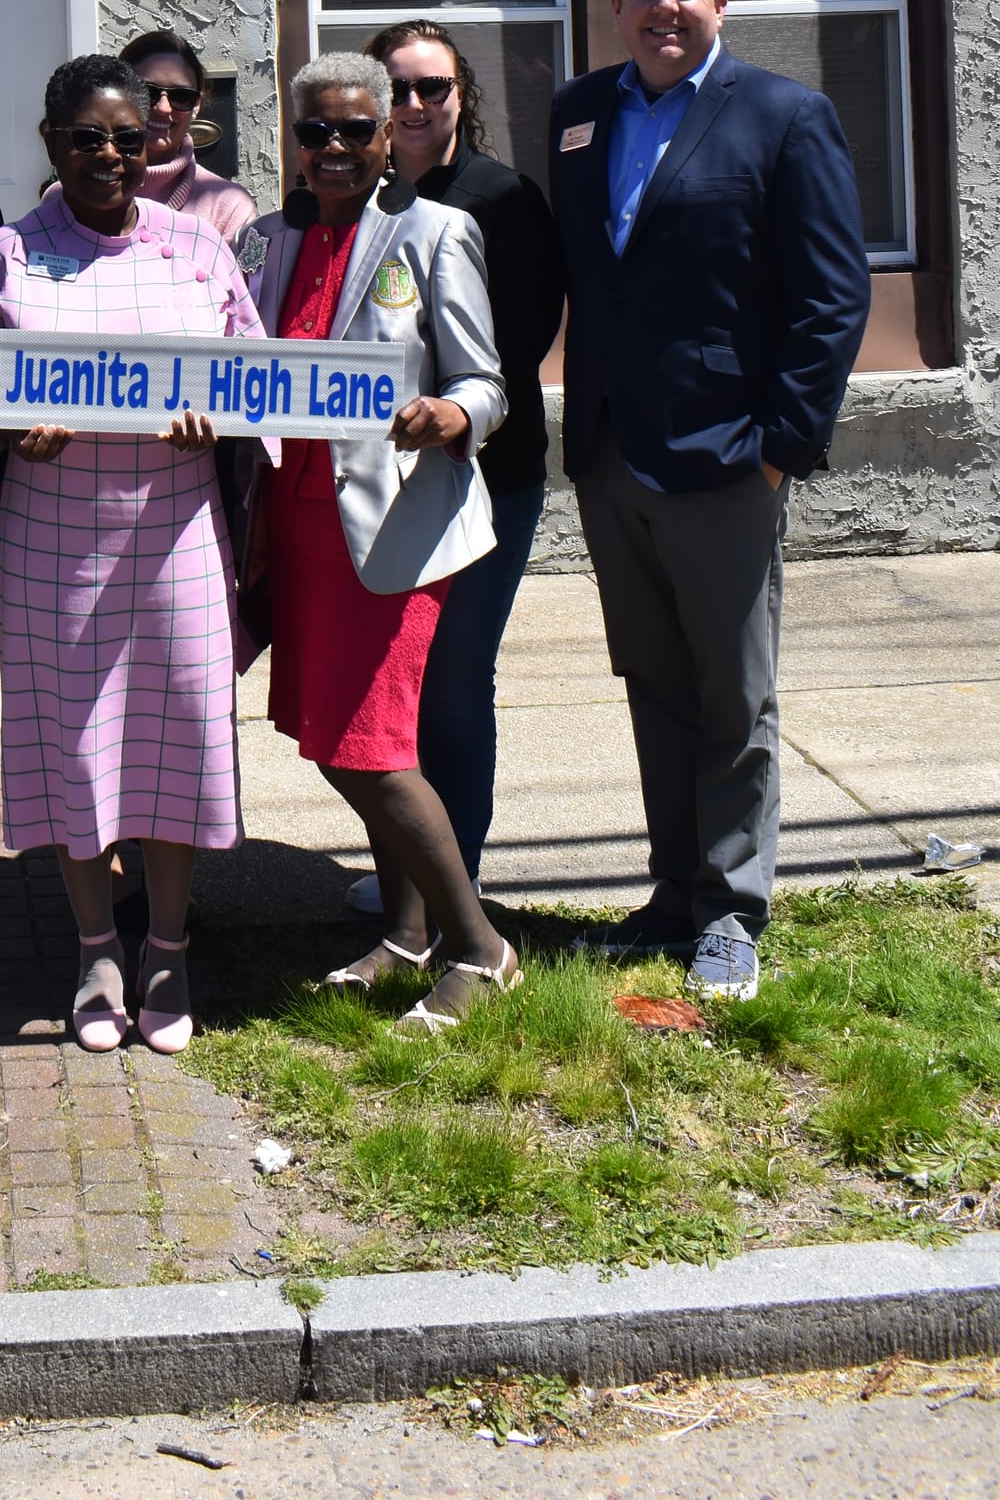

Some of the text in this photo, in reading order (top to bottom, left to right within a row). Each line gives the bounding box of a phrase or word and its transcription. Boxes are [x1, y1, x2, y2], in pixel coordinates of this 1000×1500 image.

[6, 350, 148, 408] Juanita
[164, 358, 190, 410] J.
[209, 356, 291, 423] High
[309, 364, 394, 420] Lane
